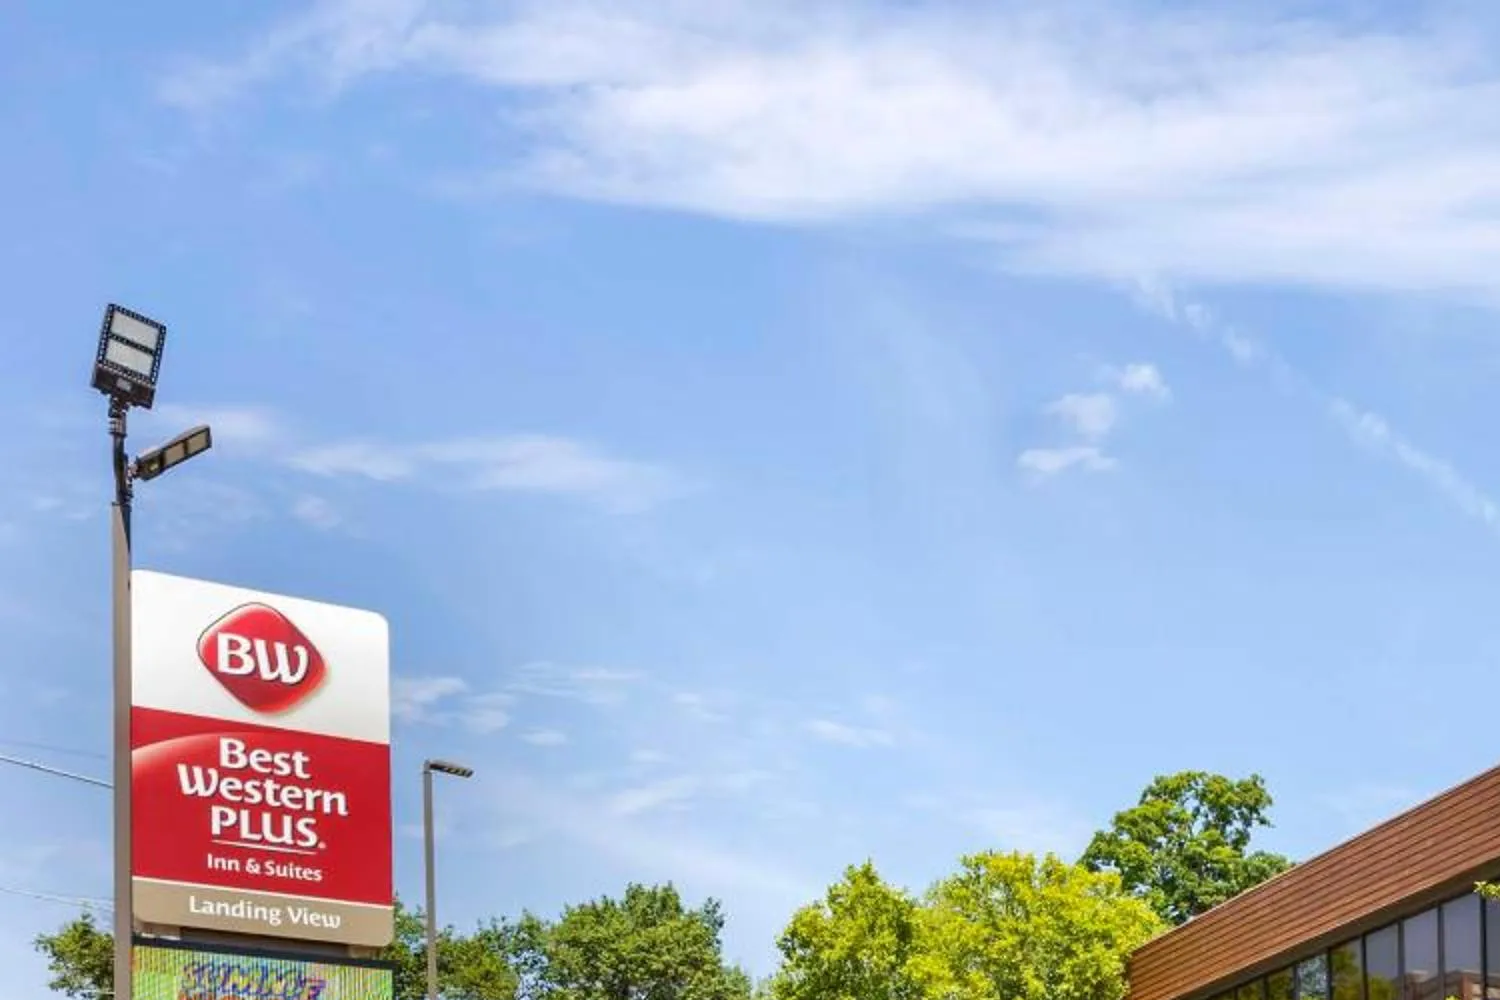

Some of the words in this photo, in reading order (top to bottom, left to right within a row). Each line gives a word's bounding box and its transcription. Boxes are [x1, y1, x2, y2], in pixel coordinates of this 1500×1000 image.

[216, 631, 309, 685] BW
[219, 736, 311, 779] Best
[176, 763, 348, 816] Western
[207, 853, 240, 872] Inn
[245, 858, 261, 874] &
[264, 860, 323, 882] Suites
[189, 895, 282, 926] Landing
[287, 906, 341, 929] View
